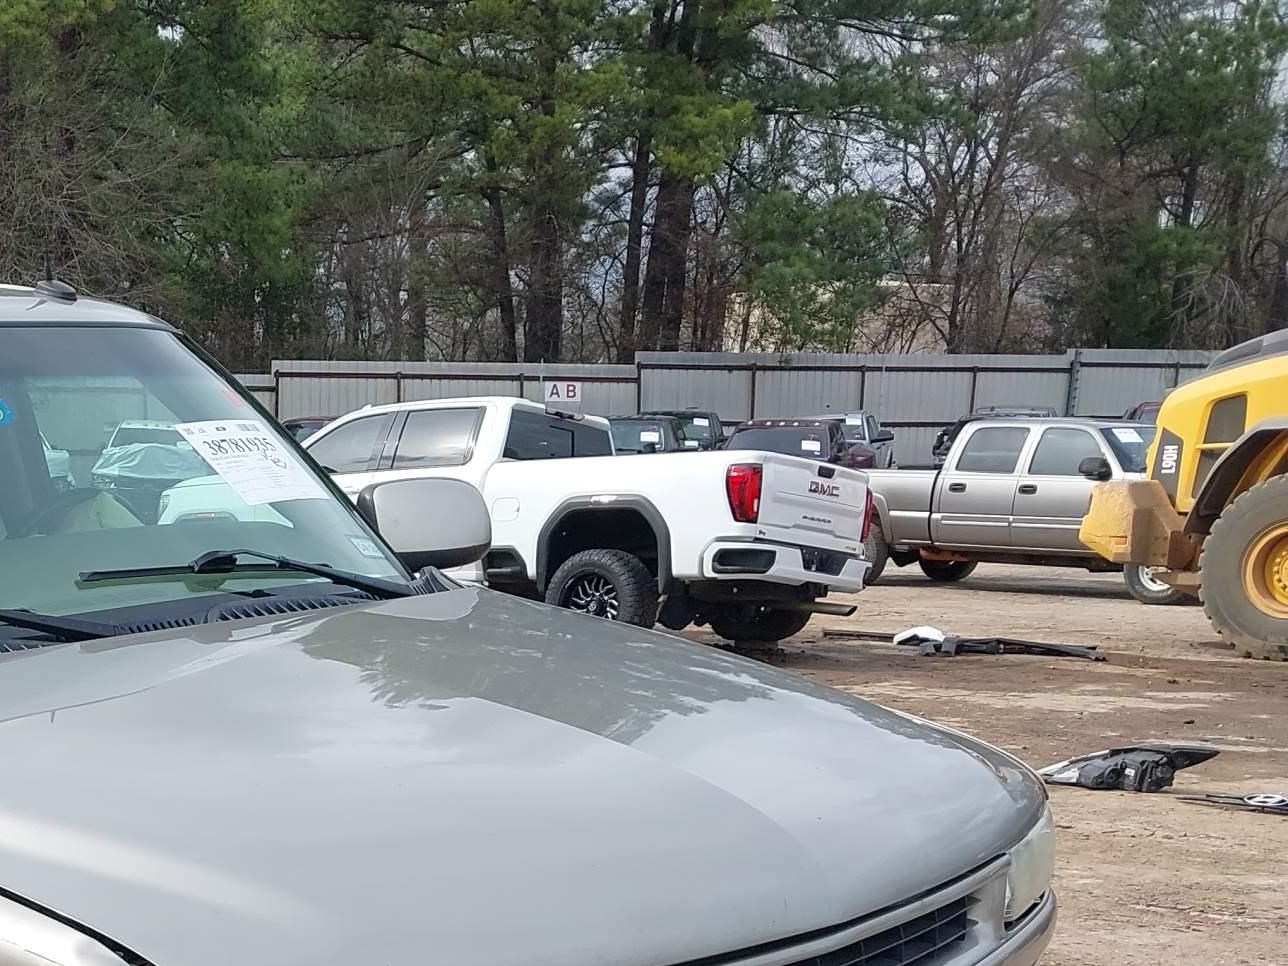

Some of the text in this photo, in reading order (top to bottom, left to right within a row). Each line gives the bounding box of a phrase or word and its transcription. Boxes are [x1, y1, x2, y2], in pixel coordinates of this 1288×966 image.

[550, 384, 577, 399] A B
[202, 436, 277, 456] 38781935
[1161, 445, 1178, 474] L90H
[808, 480, 840, 498] GMC
